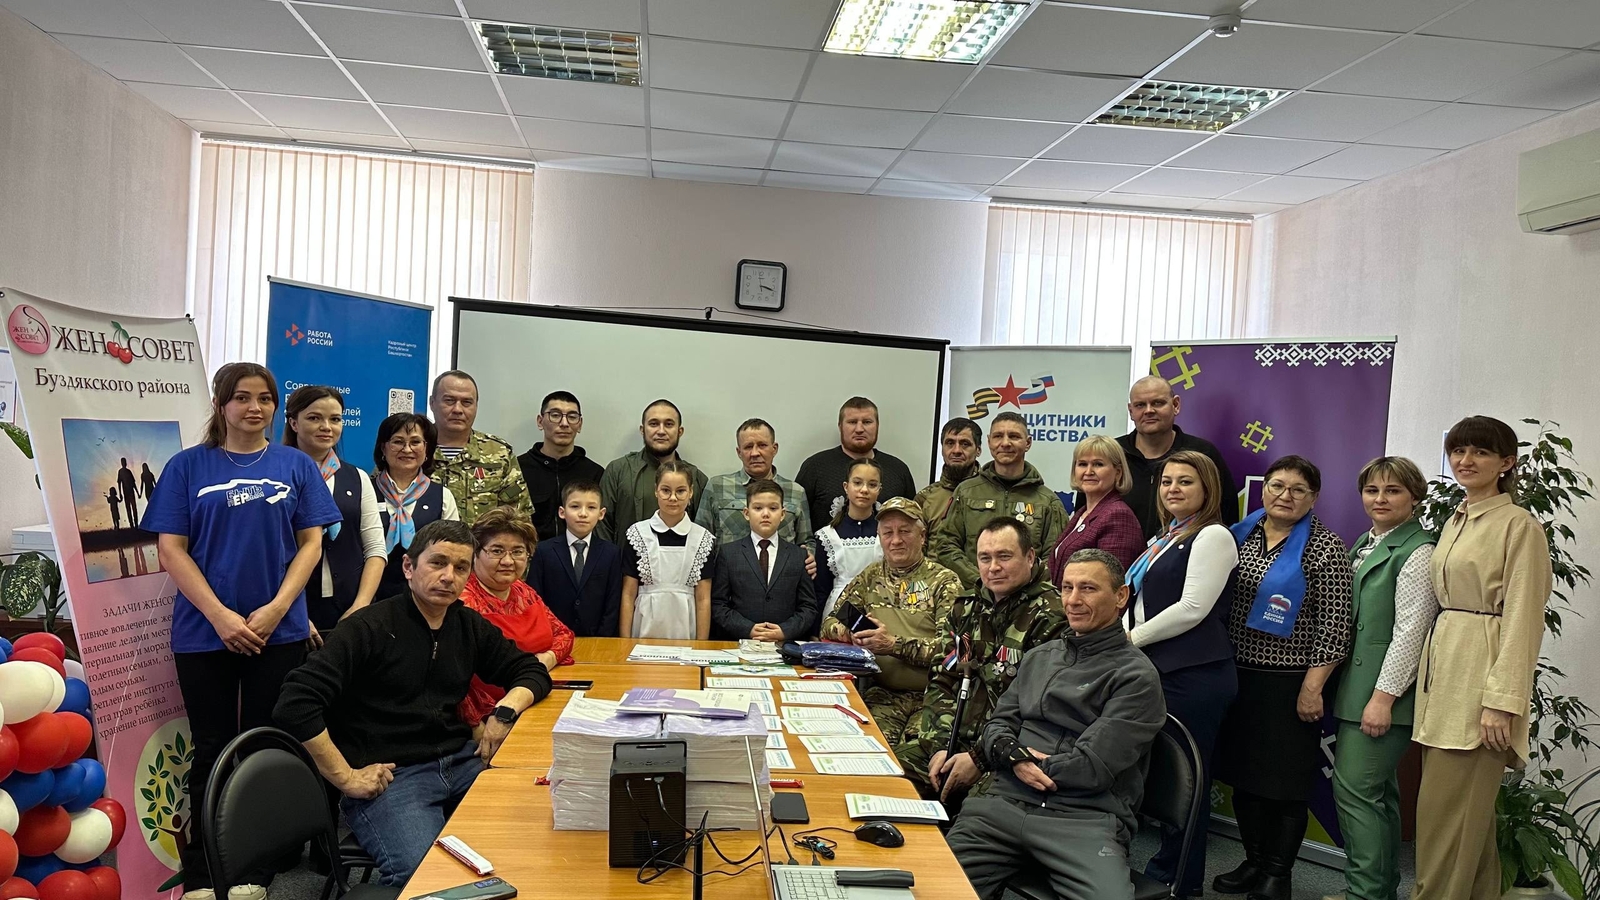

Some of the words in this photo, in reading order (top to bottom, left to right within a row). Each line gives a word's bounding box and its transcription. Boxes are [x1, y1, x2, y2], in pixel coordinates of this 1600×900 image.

[307, 330, 332, 339] РАБОТА
[307, 337, 333, 347] РОССИИ
[34, 367, 133, 393] Буздякского
[138, 378, 190, 399] района
[1023, 413, 1106, 428] ЩИТНИКИ
[1028, 429, 1089, 442] ЧЕСТВА
[103, 602, 141, 618] ЗАДАЧИ
[111, 617, 158, 634] вовлечение
[160, 615, 173, 623] же
[118, 633, 150, 648] делами
[115, 675, 148, 689] семьям.
[94, 692, 132, 713] репление
[134, 680, 175, 698] института
[113, 708, 133, 721] прав
[134, 696, 169, 716] ребёнка.
[99, 720, 138, 741] хранение
